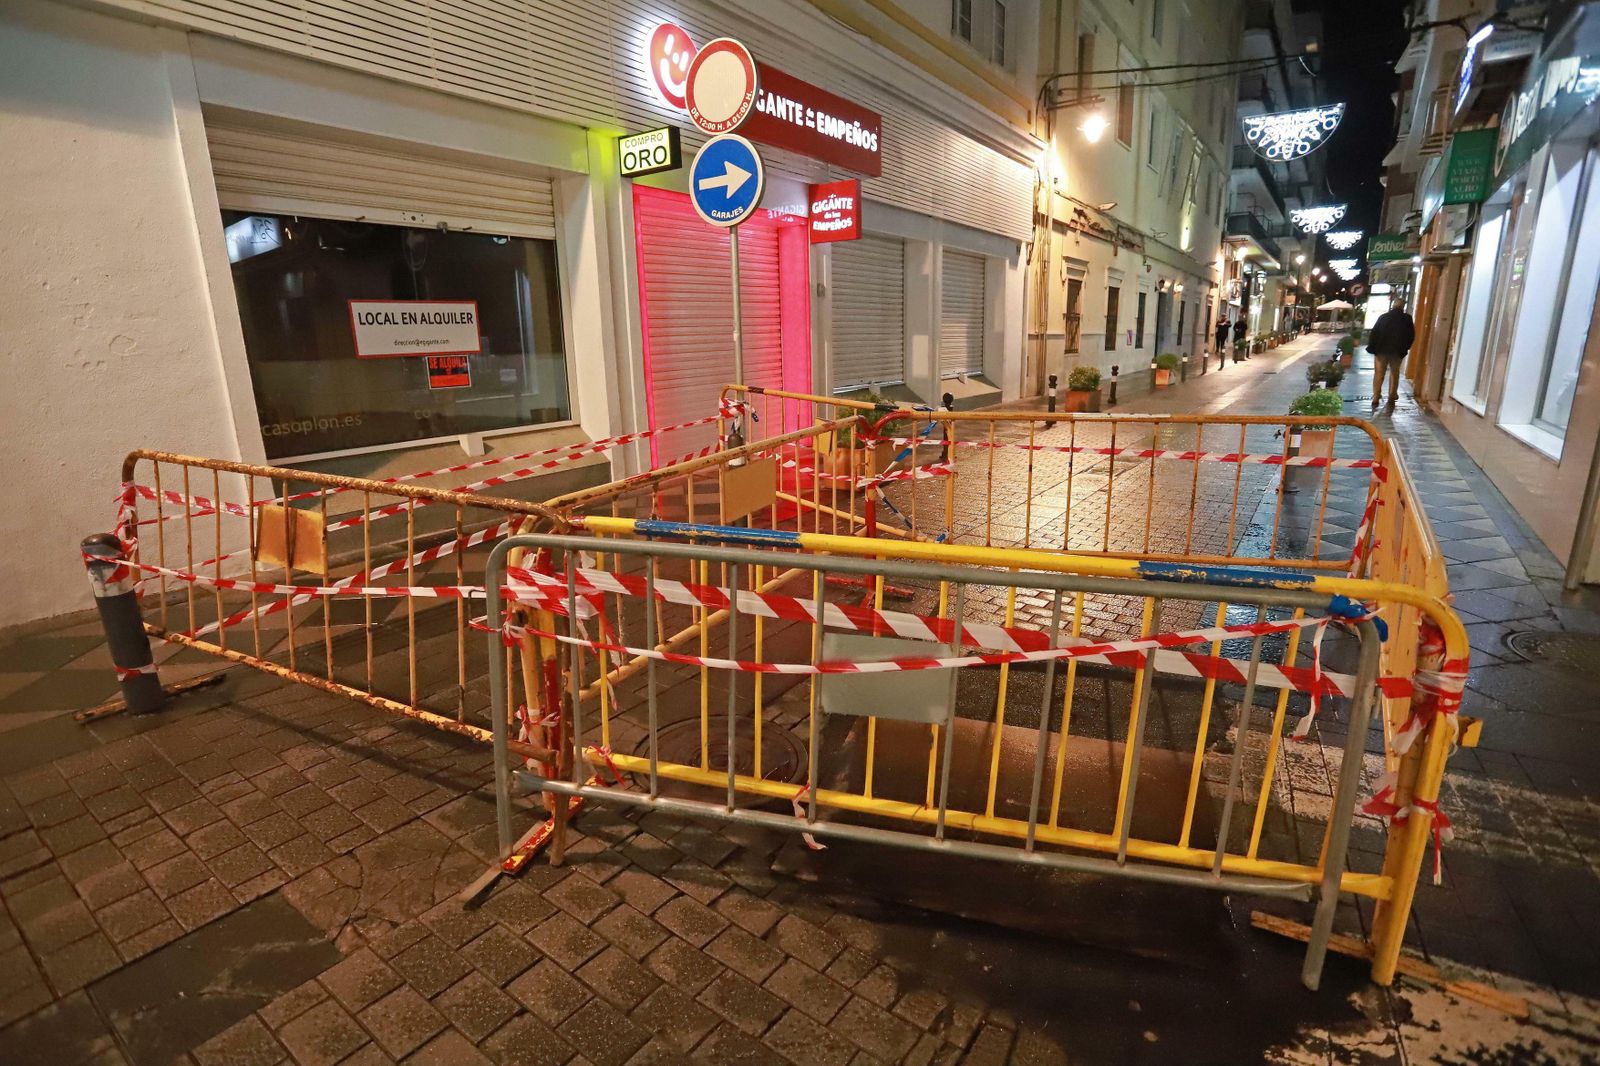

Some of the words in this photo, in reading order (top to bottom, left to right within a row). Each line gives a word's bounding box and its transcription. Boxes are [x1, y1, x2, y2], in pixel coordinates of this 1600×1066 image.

[756, 89, 803, 126] GANTE
[817, 111, 878, 152] EMPEÑOS
[625, 133, 663, 149] COMPRO
[624, 145, 667, 171] ORO
[711, 206, 744, 218] GARAJES
[812, 198, 854, 214] GIGANTE
[813, 217, 853, 231] EMPEÑOS
[358, 312, 399, 325] LOCAL
[401, 312, 417, 325] EN
[420, 312, 473, 325] ALQUILER
[429, 357, 438, 369] SE
[440, 356, 467, 369] ALQUILA
[261, 413, 363, 436] casoplon.es
